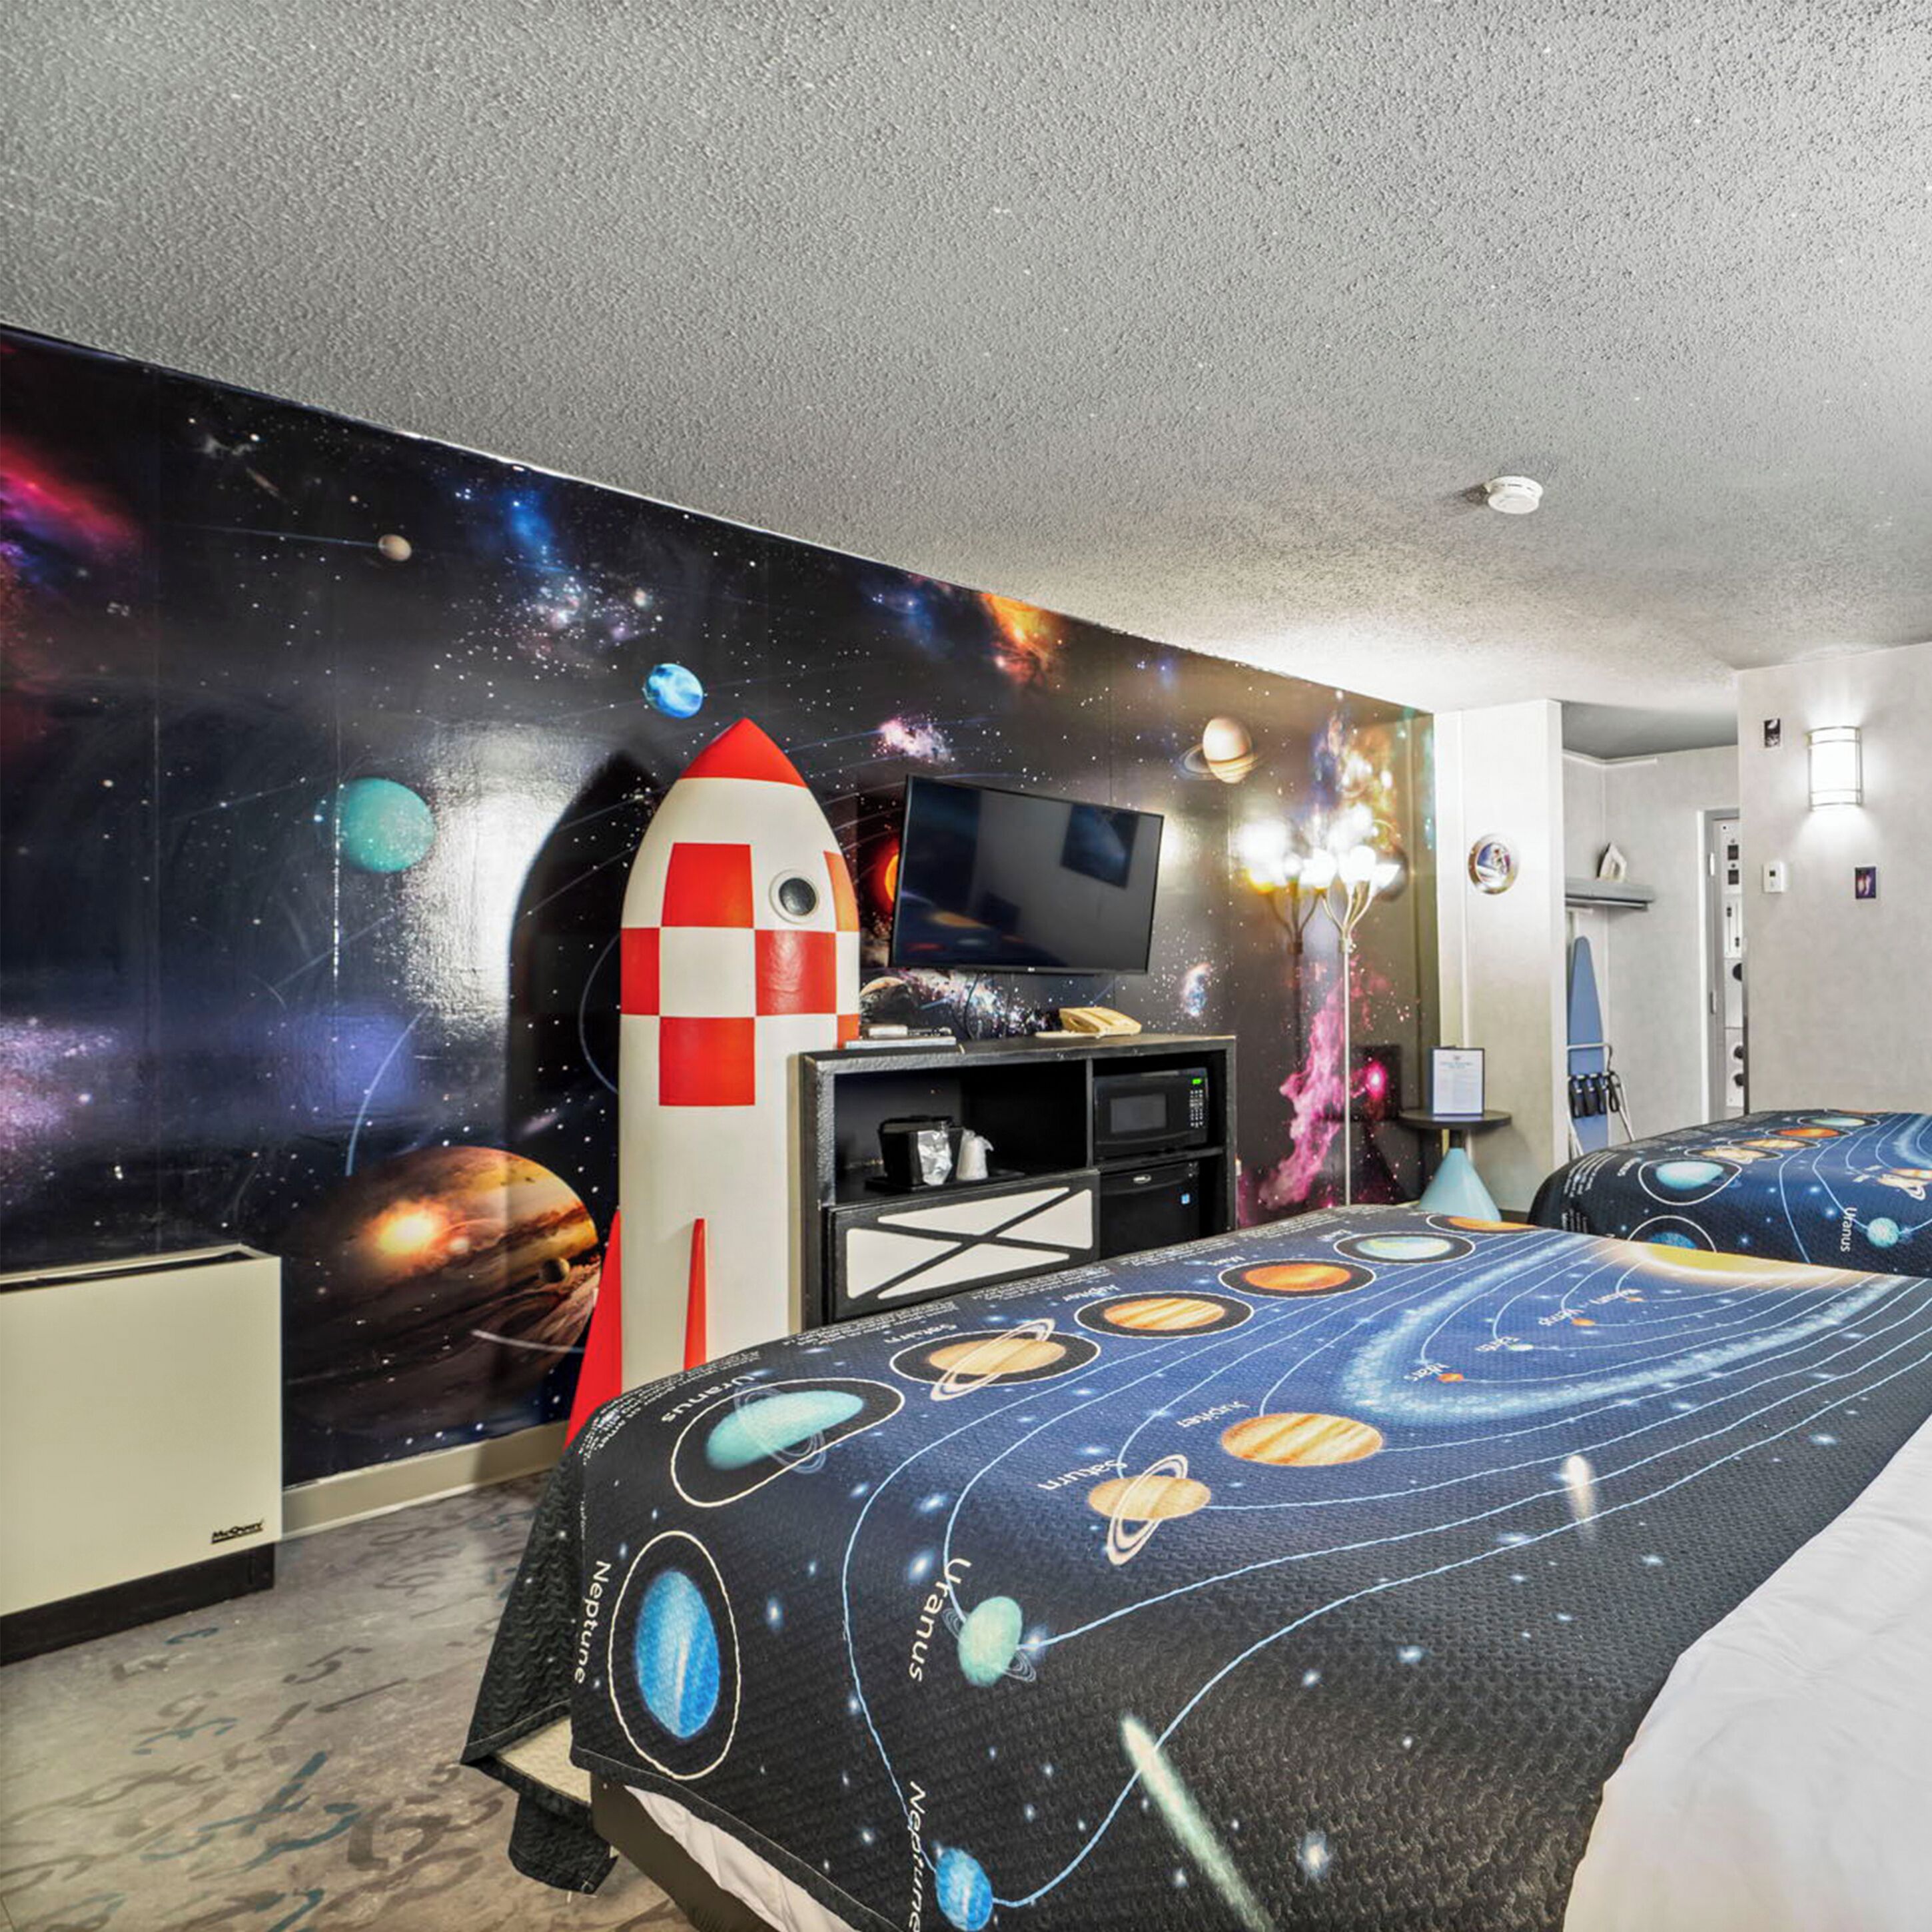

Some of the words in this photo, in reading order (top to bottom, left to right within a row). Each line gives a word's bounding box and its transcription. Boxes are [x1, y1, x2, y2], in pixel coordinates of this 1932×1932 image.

[1840, 1207, 1858, 1252] Uranus
[883, 1324, 958, 1344] Saturn
[661, 1375, 755, 1422] Uranus
[1176, 1400, 1250, 1428] Jupiter
[1037, 1460, 1128, 1490] Saturn
[574, 1560, 612, 1684] Neptune
[909, 1558, 973, 1683] Uranus
[907, 1781, 926, 1932] Neptune
